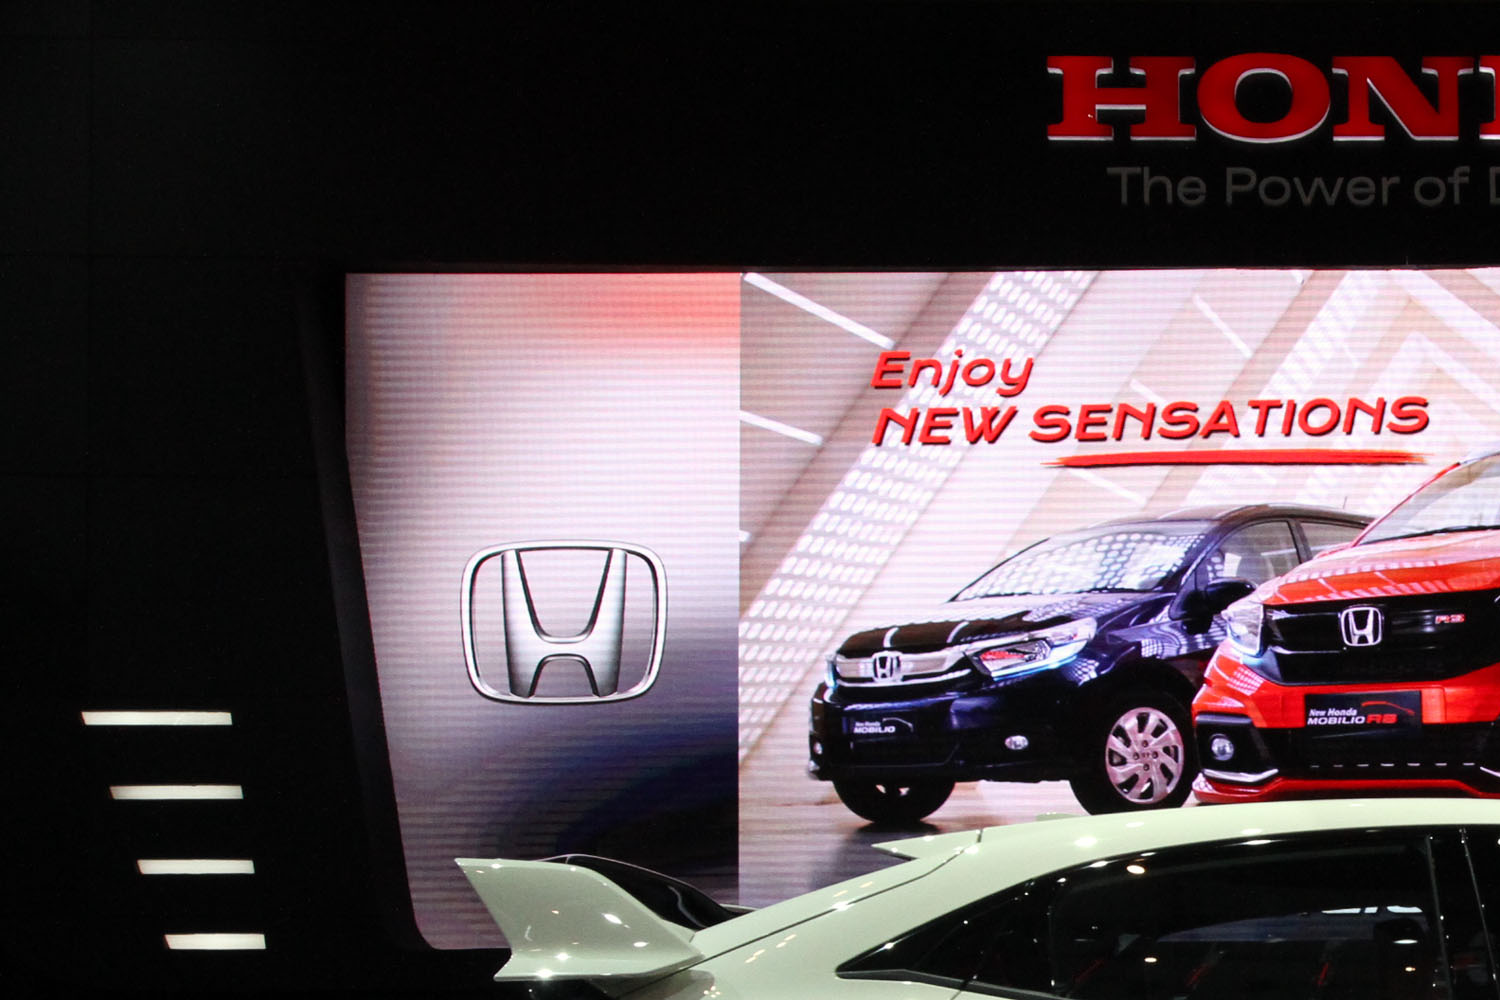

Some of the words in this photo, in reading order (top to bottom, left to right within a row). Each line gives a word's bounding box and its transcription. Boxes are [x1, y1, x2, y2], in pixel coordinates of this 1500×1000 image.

[1107, 166, 1207, 206] The
[1225, 166, 1400, 206] Power
[1414, 165, 1471, 205] of
[870, 349, 1034, 397] Enjoy
[871, 405, 1019, 446] NEW
[1028, 396, 1431, 443] SENSATIONS
[1307, 716, 1365, 726] MOBILIO
[1327, 707, 1357, 716] Honda
